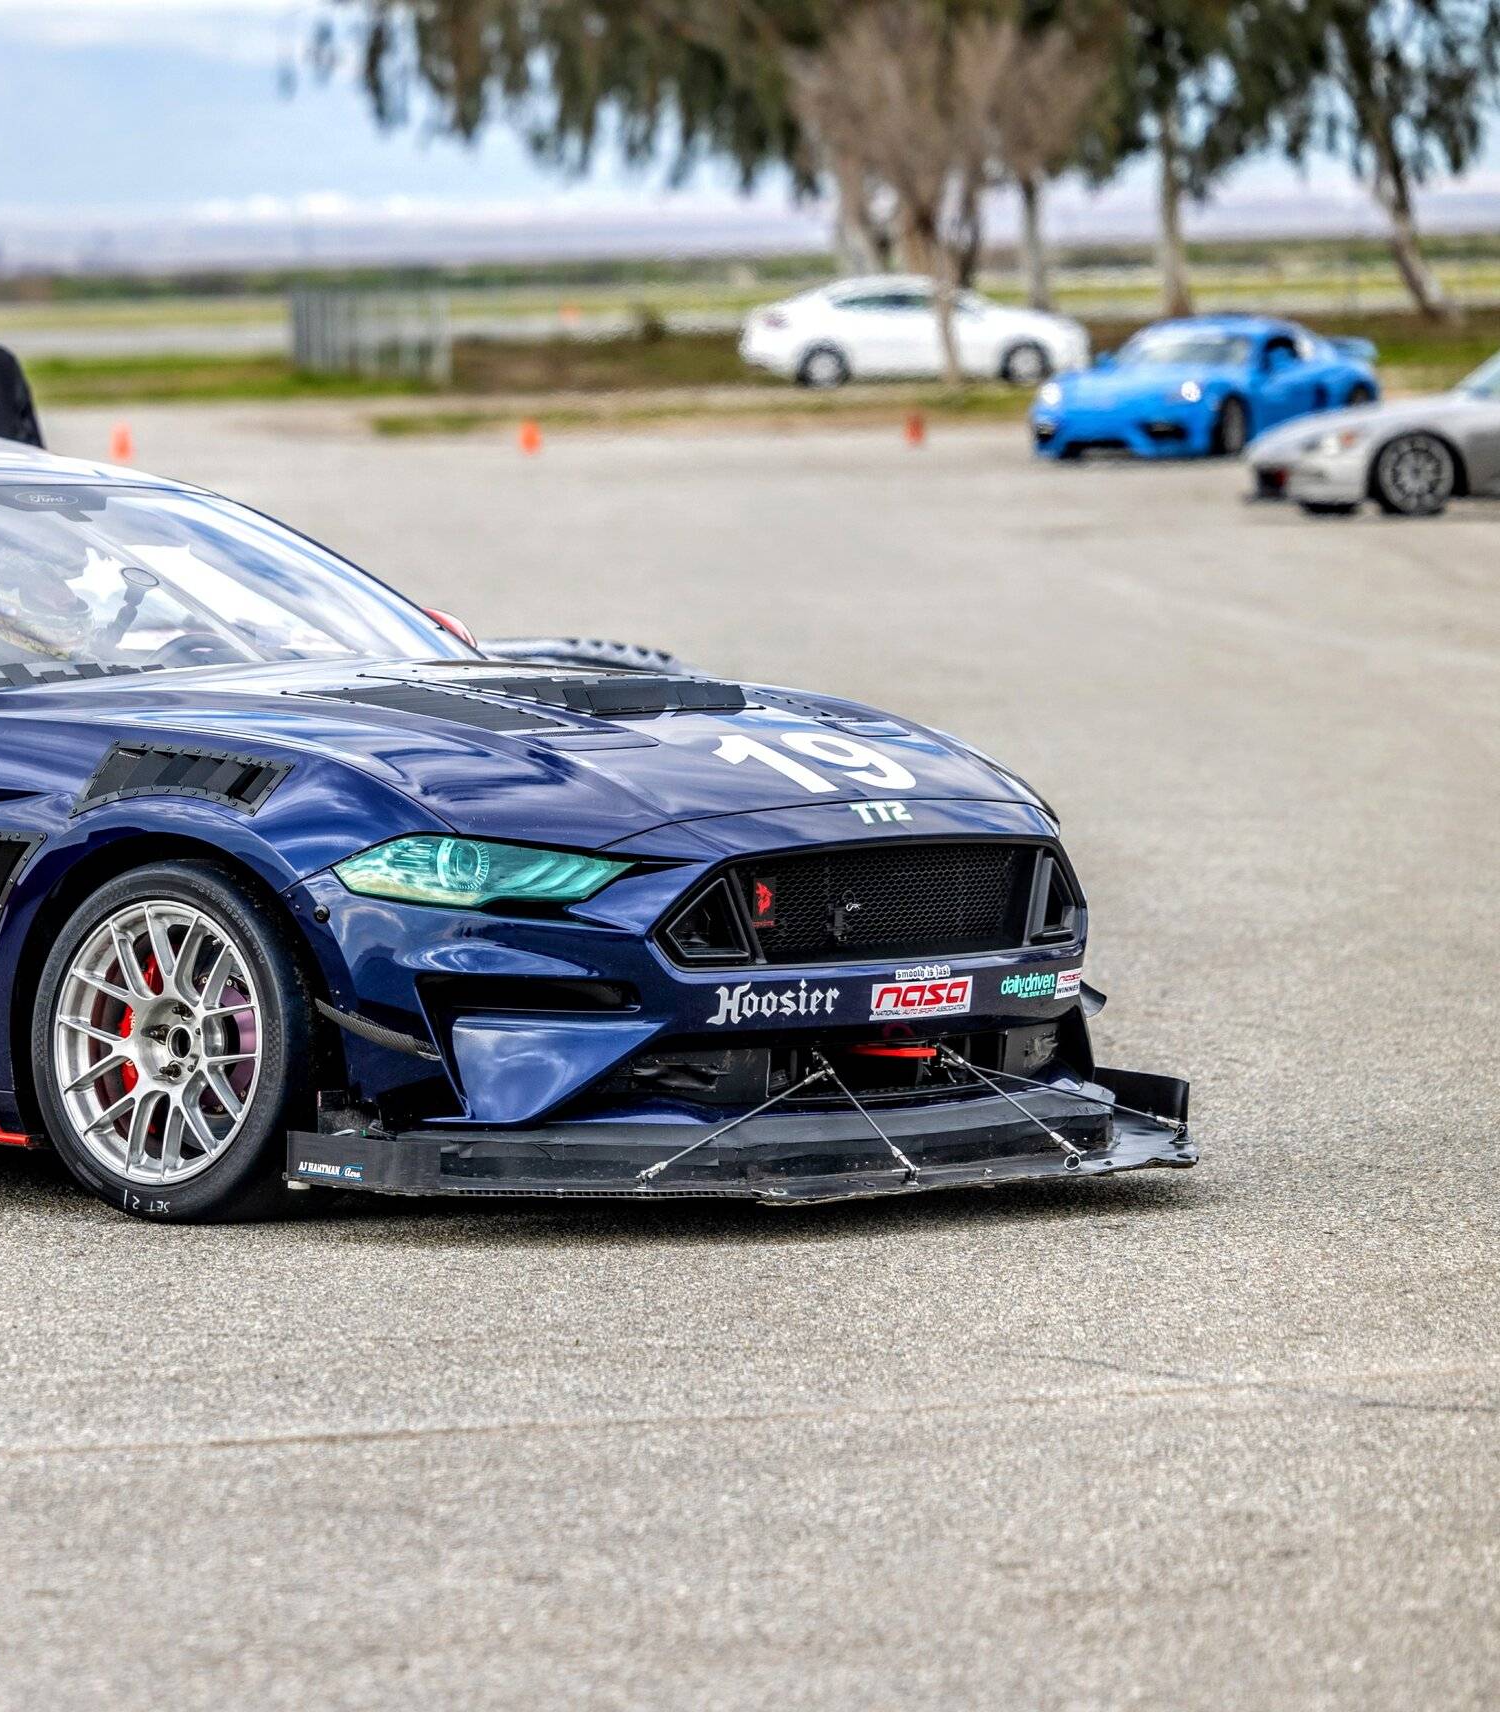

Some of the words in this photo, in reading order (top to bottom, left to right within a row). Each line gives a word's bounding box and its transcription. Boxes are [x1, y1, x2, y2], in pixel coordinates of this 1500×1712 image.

[711, 732, 917, 794] 19
[849, 801, 913, 825] TT2
[706, 979, 840, 1026] Hoosier
[298, 1161, 308, 1171] AJ
[308, 1162, 341, 1176] HARTMAN
